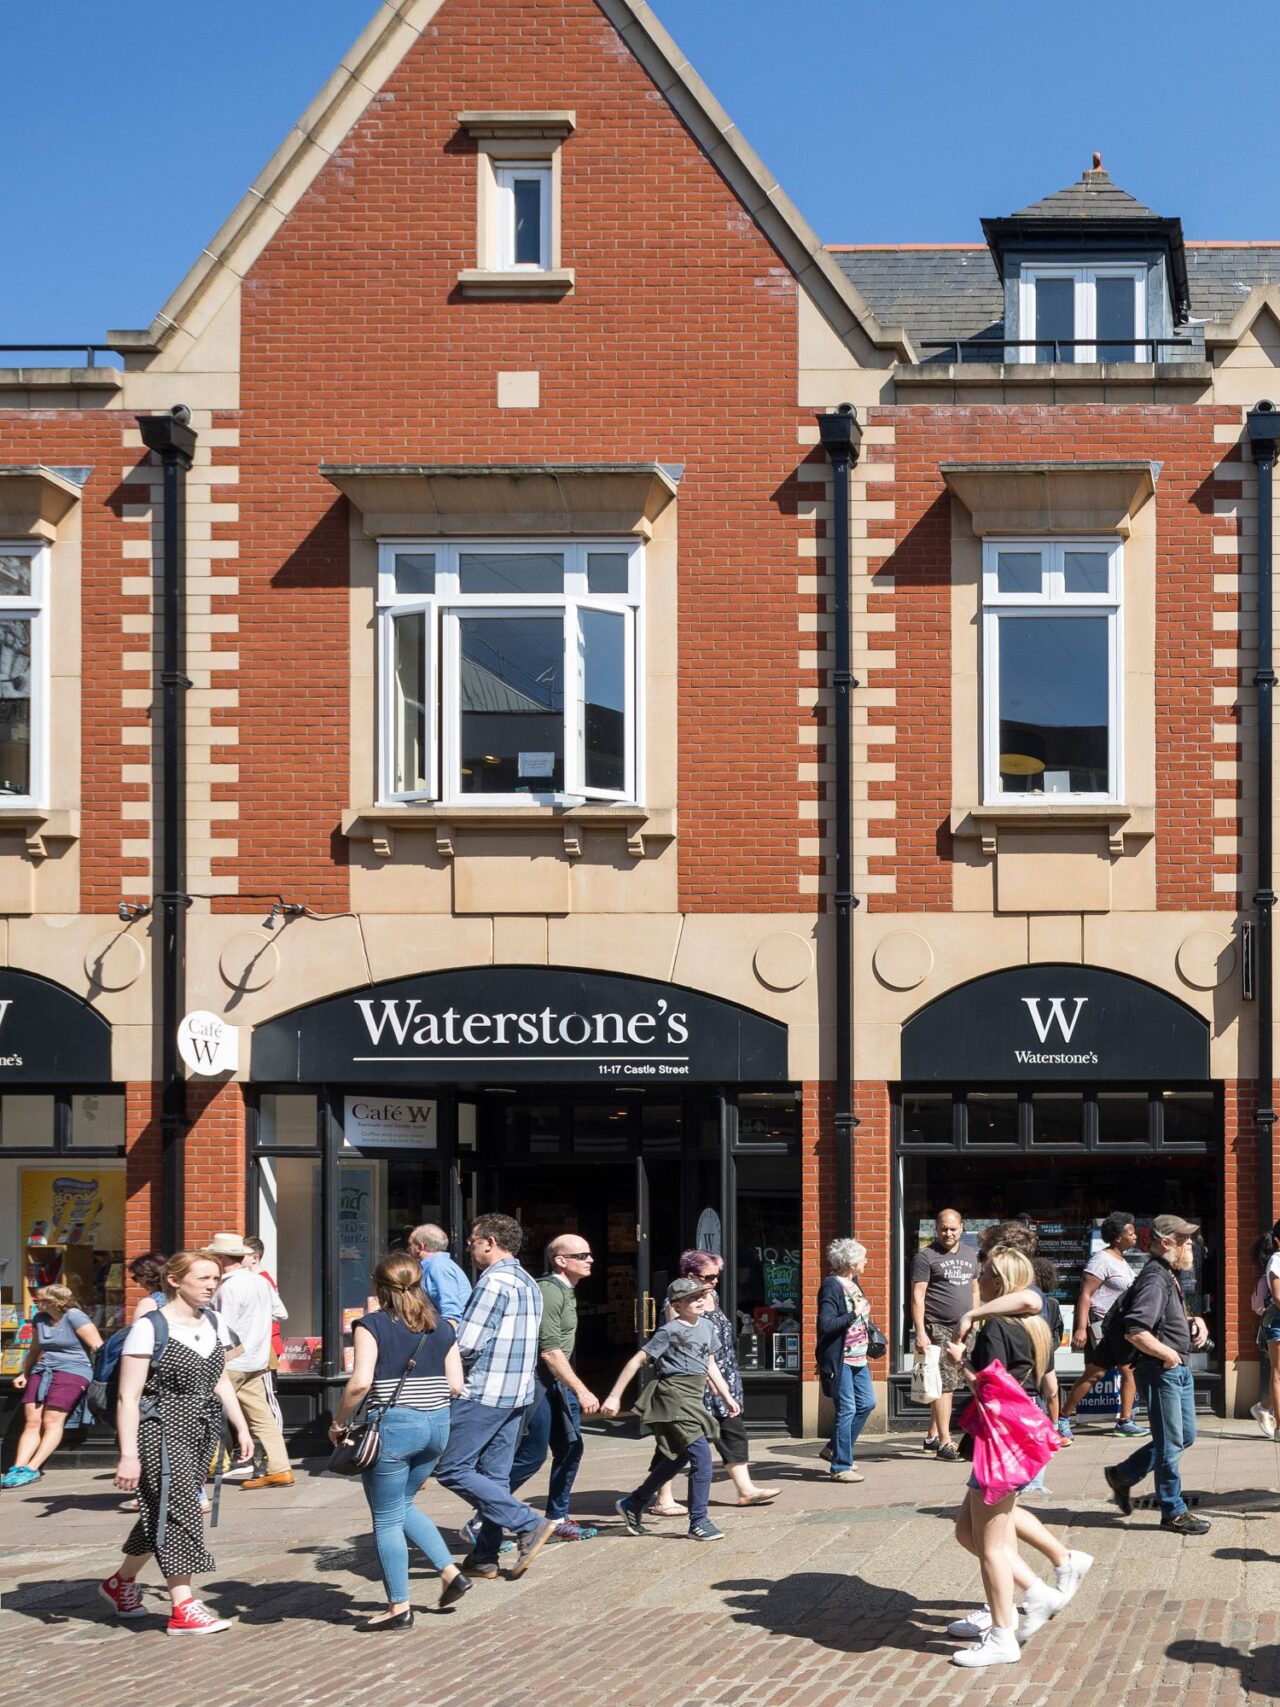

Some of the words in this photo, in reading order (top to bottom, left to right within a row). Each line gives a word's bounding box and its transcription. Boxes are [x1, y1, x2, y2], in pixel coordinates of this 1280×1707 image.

[188, 1018, 222, 1039] Café
[353, 999, 689, 1046] Waterstone's
[1021, 997, 1088, 1044] W
[190, 1038, 220, 1067] W
[1015, 1050, 1098, 1064] Waterstone's
[598, 1064, 621, 1075] 11-17
[624, 1064, 656, 1075] Castle
[658, 1064, 690, 1075] Street
[352, 1103, 403, 1121] Café
[406, 1105, 432, 1123] W
[703, 1233, 715, 1251] W
